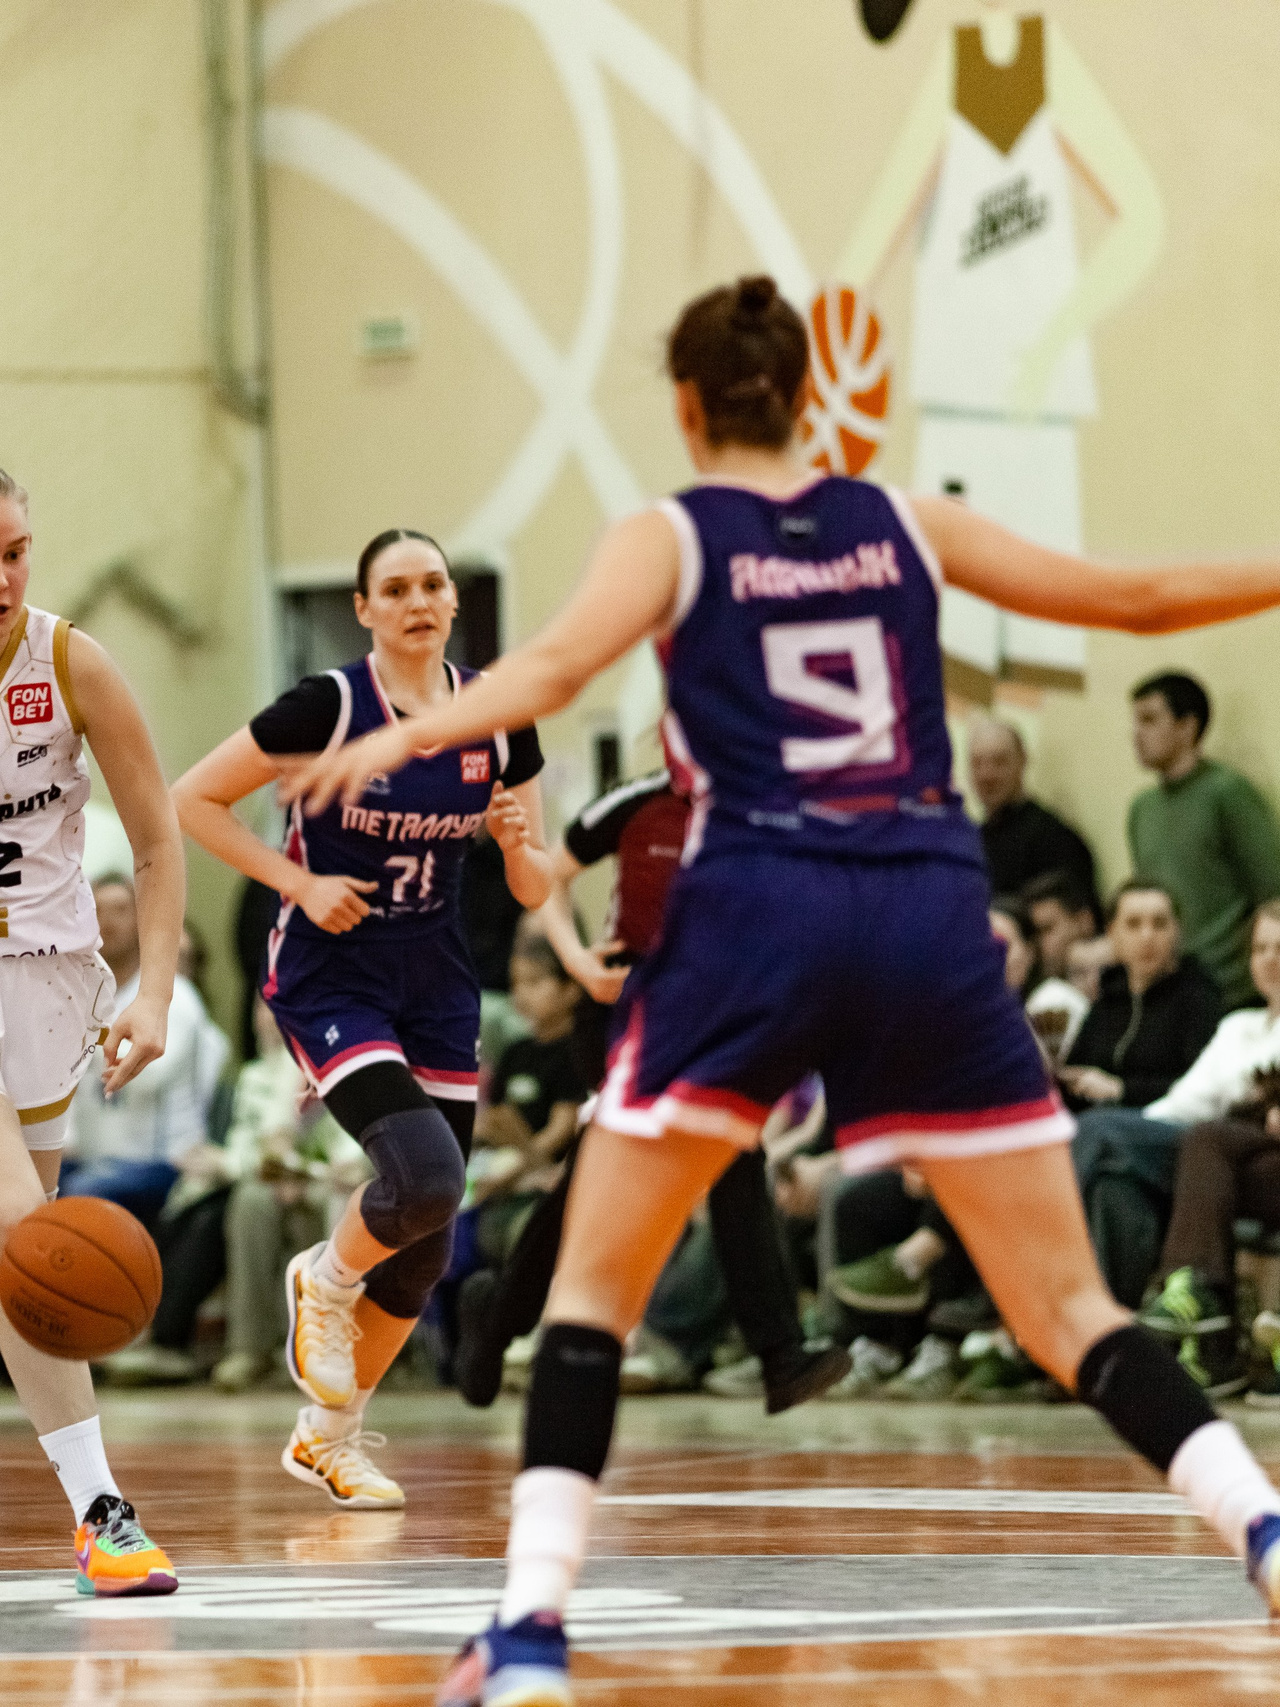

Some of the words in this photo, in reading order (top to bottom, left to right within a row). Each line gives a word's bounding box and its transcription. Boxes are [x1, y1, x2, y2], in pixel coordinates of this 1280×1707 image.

[11, 687, 48, 704] FON
[761, 615, 896, 773] 9
[13, 702, 49, 720] BET
[462, 753, 487, 767] FON
[463, 766, 487, 781] BET
[384, 850, 436, 902] 71
